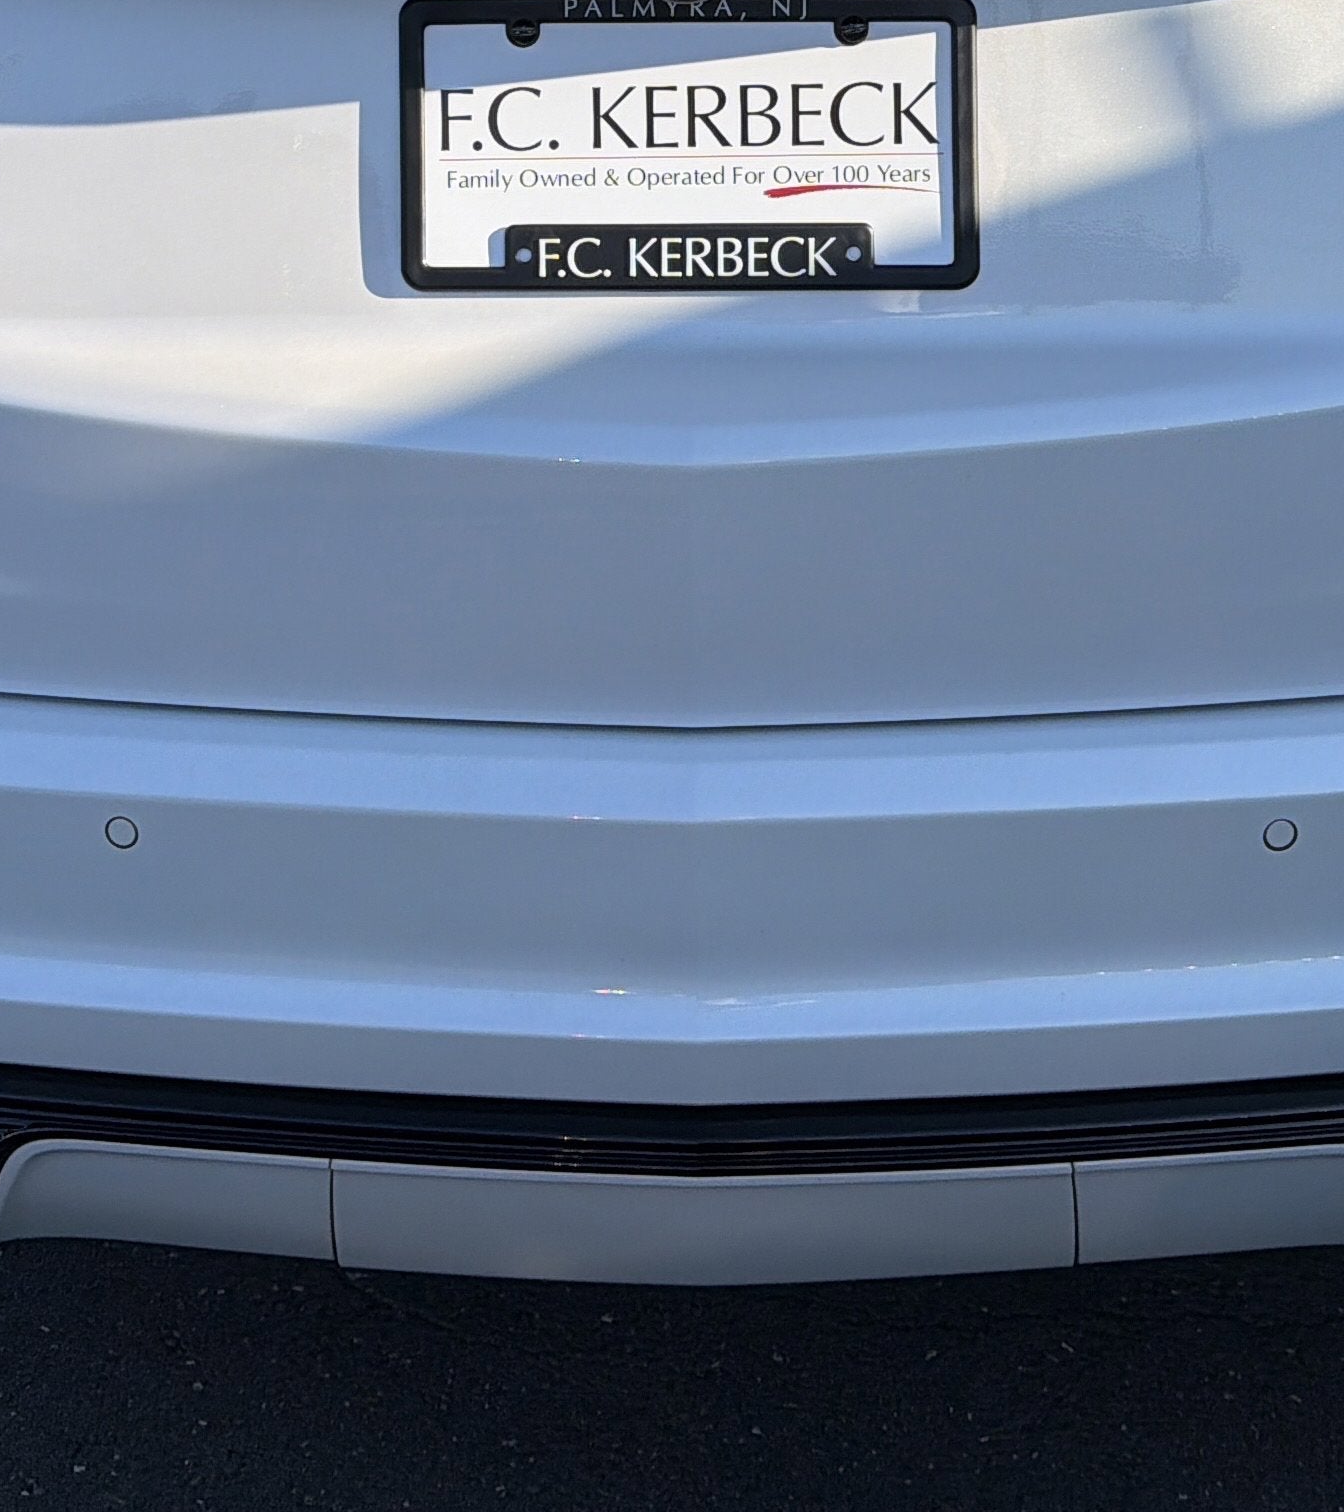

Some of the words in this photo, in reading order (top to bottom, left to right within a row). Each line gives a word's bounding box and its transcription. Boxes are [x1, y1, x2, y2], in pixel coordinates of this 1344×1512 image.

[440, 86, 560, 152] F.C.
[592, 81, 940, 149] KERBECK
[447, 169, 514, 193] Family
[519, 168, 596, 188] Owned
[603, 168, 619, 186] &
[627, 165, 725, 191] Operated
[733, 166, 765, 185] For
[773, 165, 824, 184] Over
[832, 165, 869, 183] 100
[877, 164, 931, 183] Years
[538, 237, 612, 278] F.C.
[629, 236, 837, 278] KERBECK
